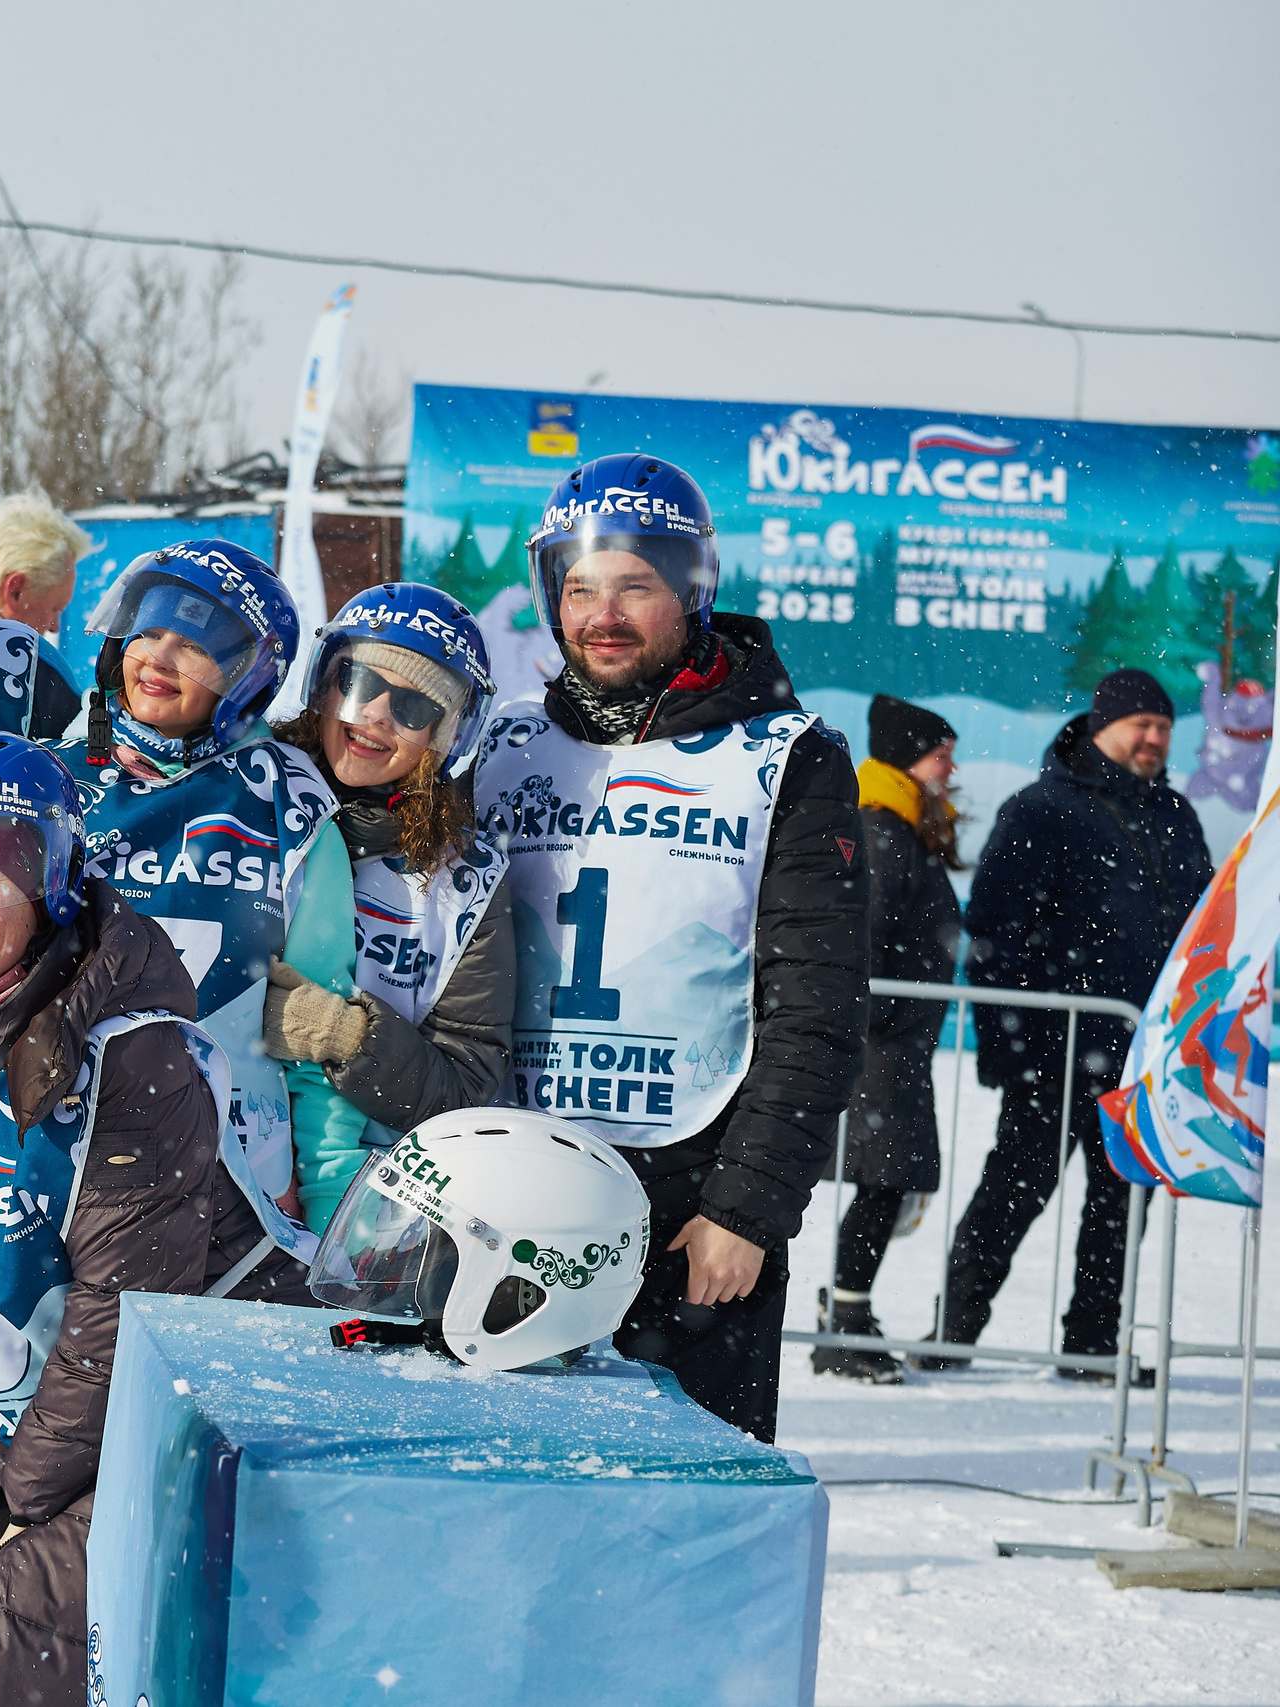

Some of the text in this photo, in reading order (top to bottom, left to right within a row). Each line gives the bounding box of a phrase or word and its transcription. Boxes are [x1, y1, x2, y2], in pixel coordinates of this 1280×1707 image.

[666, 514, 695, 525] ПЕРВЫЕ
[673, 524, 700, 536] РОССИИ
[758, 564, 857, 587] АПРЕЛЯ
[963, 575, 1047, 602] ТОЛК
[244, 597, 269, 626] ПЕРВЫЕ
[755, 589, 855, 624] 2025
[894, 597, 1048, 633] В СНЕГЕ
[245, 608, 268, 638] РОССИИ
[4, 805, 39, 818] РОССИИ
[546, 843, 573, 852] REGION
[669, 848, 745, 866] СНЕЖНЫЙ БОЙ
[549, 867, 620, 1021] 1
[529, 1058, 561, 1069] ЗНАЕТ
[536, 1041, 562, 1056] ТЕХ,
[569, 1042, 675, 1075] ТОЛК
[514, 1073, 674, 1115] В СНЕГЕ
